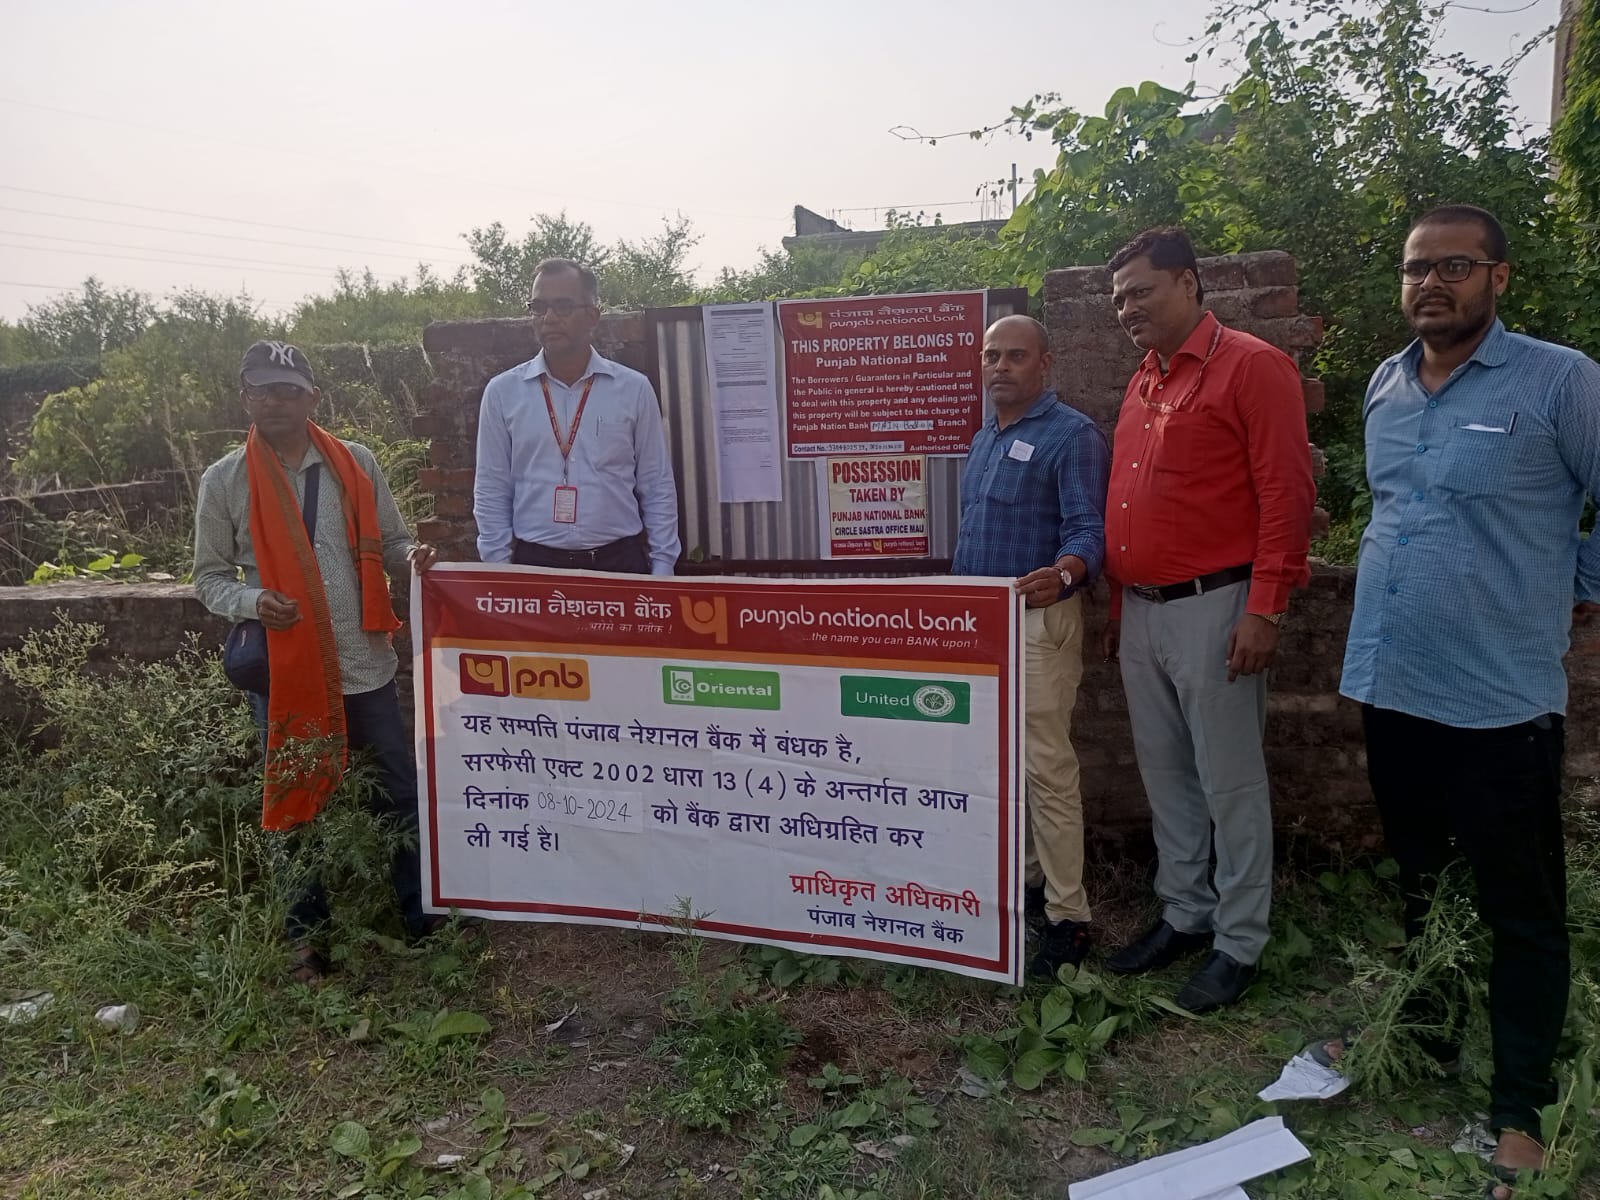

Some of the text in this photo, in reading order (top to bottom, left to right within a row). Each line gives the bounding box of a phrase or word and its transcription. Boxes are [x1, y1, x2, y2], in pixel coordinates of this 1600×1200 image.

[829, 312, 966, 330] punjab national bank
[791, 331, 975, 354] THIS PROPERTY BELONGS TO
[816, 351, 948, 370] Punjab National Bank
[791, 376, 806, 385] The
[807, 375, 849, 384] Borrowers
[902, 372, 911, 380] in
[912, 370, 954, 380] Particular
[956, 369, 972, 378] and
[808, 387, 833, 396] Public
[834, 386, 843, 395] in
[844, 385, 875, 396] general
[876, 385, 884, 393] is
[886, 384, 914, 394] hereby
[916, 382, 958, 391] cautioned
[959, 382, 973, 390] not
[792, 393, 978, 408] to deal with this property and any dealing with
[792, 405, 971, 421] this property will be subject to the charge of
[792, 423, 818, 433] Punjab
[820, 422, 847, 431] Nation
[848, 421, 869, 430] Bank
[937, 418, 967, 427] Branch
[927, 434, 961, 443] By Order
[909, 443, 951, 452] Authorised
[952, 443, 971, 451] Offic
[832, 459, 921, 484] POSSESSION
[849, 487, 906, 503] TAKEN BY
[832, 508, 926, 522] PUNJAB NATIONAL BANK
[834, 524, 925, 536] CIRCLE SASTRA OFFICE MAU
[475, 591, 541, 615] पंजाब
[634, 593, 672, 620] बैंक
[739, 604, 977, 633] punjab national bank
[830, 634, 859, 644] name
[861, 635, 881, 646] you
[883, 636, 904, 645] can
[906, 635, 939, 648] BANK
[942, 637, 971, 649] upon
[516, 662, 584, 694] pnb
[696, 682, 772, 697] Oriental
[856, 691, 910, 707] United
[461, 713, 862, 764] यह सम्पत्ति पंजाब नेशनल बैंक में बंधक है,
[461, 747, 536, 774] सरफेसी
[542, 757, 584, 780] एक्ट
[592, 761, 655, 783] 2002
[663, 765, 704, 788] धारा
[712, 770, 737, 791] 13
[793, 770, 817, 798] के
[825, 776, 908, 806] अन्तर्गत
[917, 788, 969, 814] आज
[463, 785, 925, 850] दिनांक 08-10-2024 को बैंक द्वारा अधिग्रहित कर
[463, 822, 559, 852] ली गई है।
[789, 870, 981, 918] प्राधिकृत अधिकारी
[807, 904, 964, 945] पंजाब नेशनल बैंक
